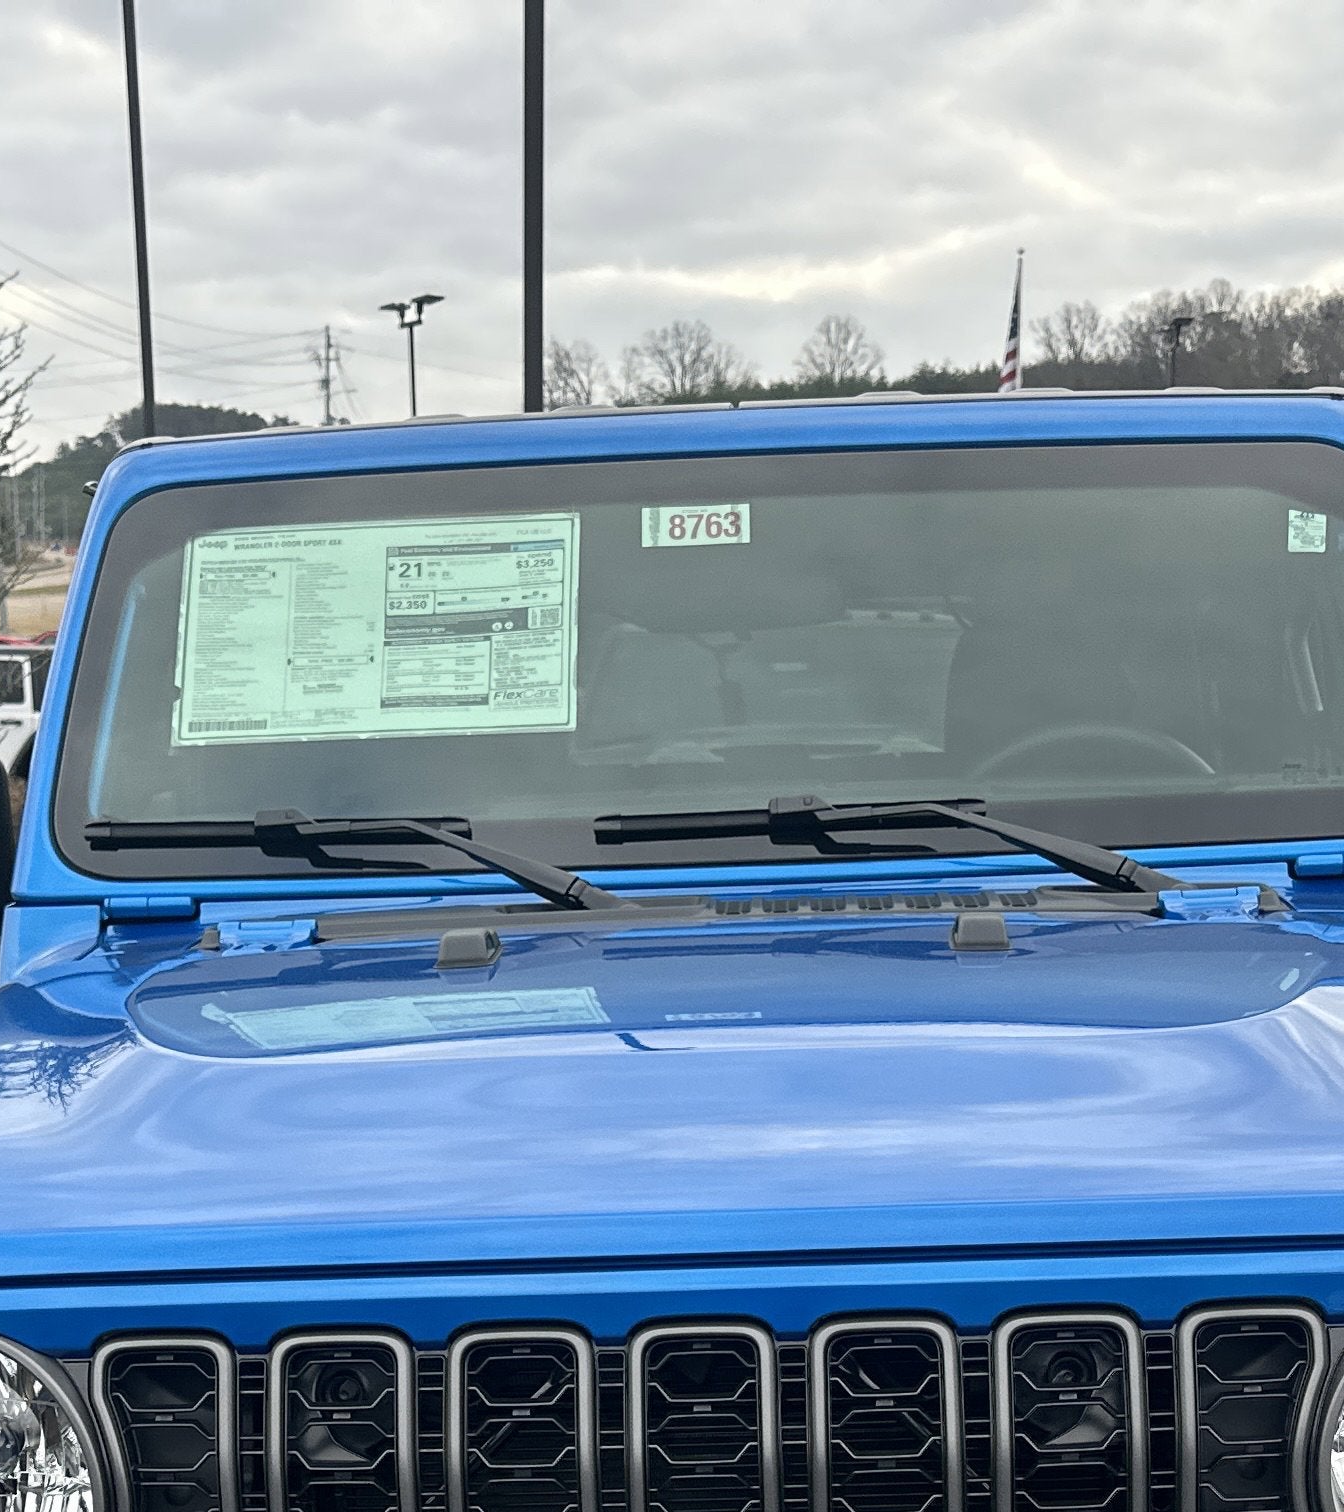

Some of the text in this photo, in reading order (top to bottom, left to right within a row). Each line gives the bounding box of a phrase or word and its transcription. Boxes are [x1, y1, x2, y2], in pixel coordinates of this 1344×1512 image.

[668, 511, 742, 540] 8763
[399, 562, 422, 578] 21
[493, 688, 559, 700] FlexCare
